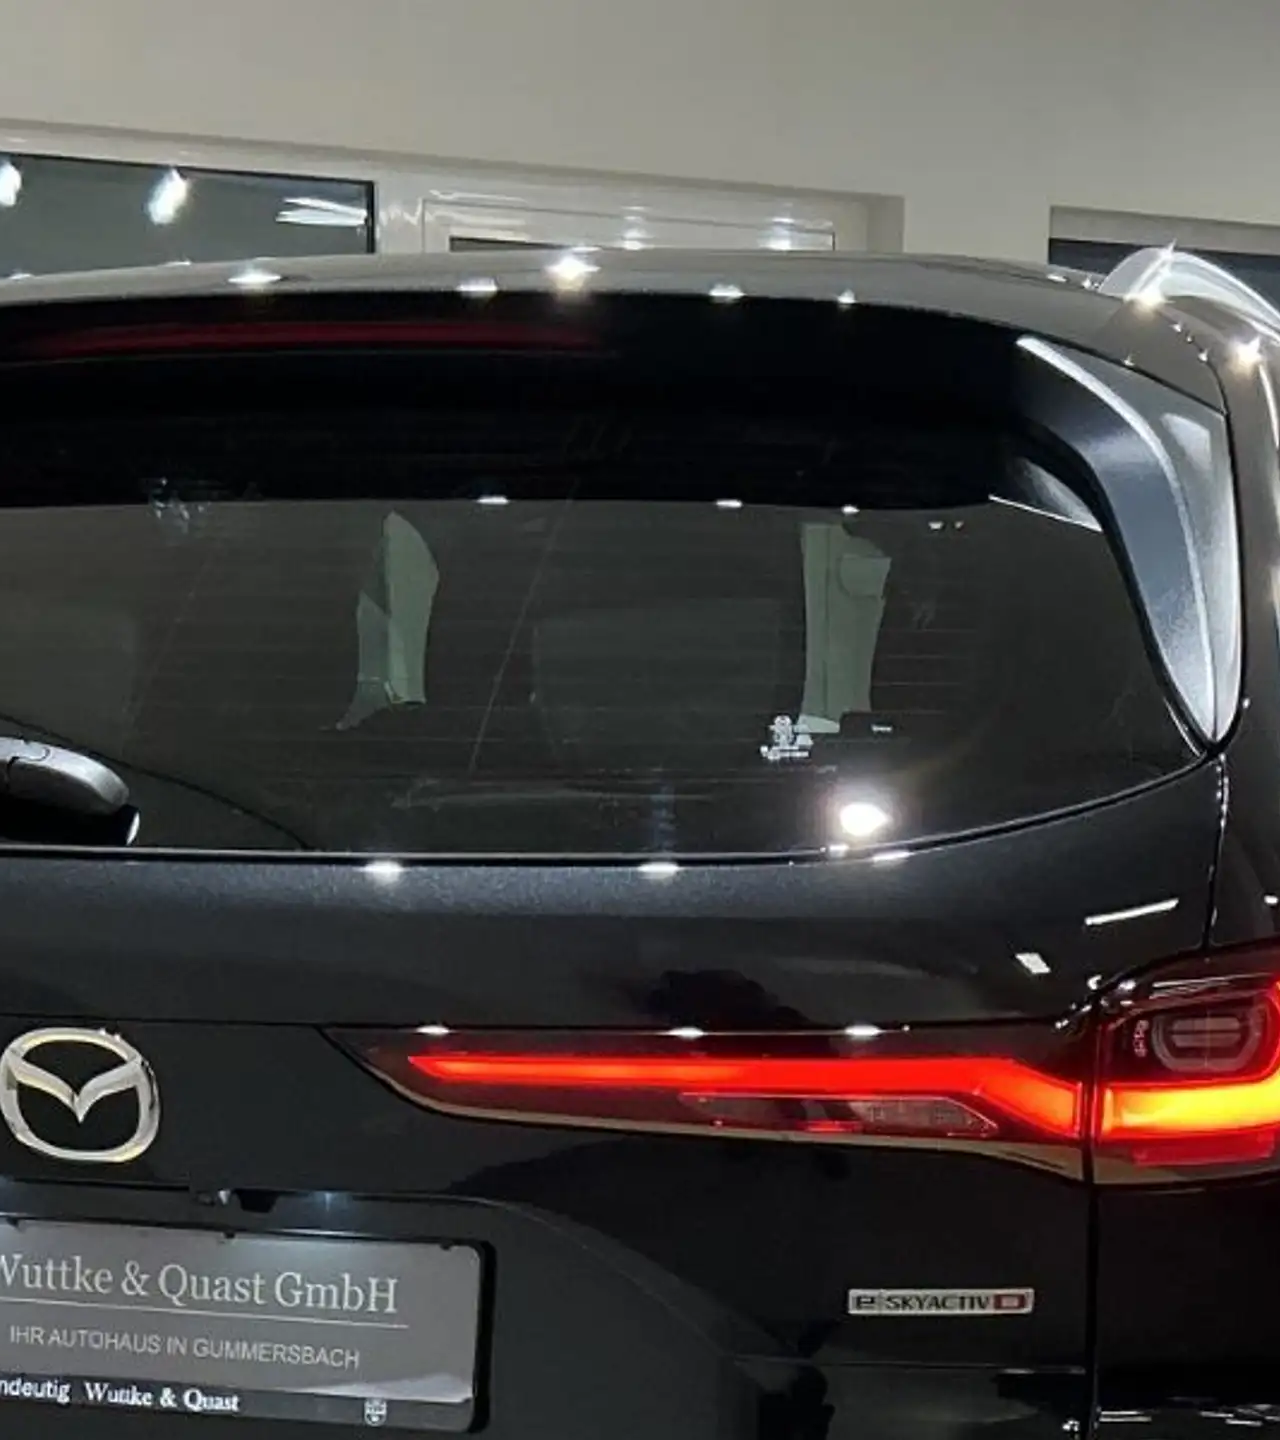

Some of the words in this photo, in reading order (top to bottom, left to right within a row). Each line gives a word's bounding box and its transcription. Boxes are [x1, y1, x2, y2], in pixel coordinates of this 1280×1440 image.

[121, 1260, 150, 1296] &
[157, 1263, 267, 1307] Quast
[275, 1271, 399, 1314] GmbH
[10, 1325, 44, 1345] IHR
[48, 1328, 162, 1355] AUTOHAUS
[166, 1336, 188, 1355] IN
[193, 1337, 360, 1369] GUMMERSBACH
[84, 1381, 154, 1406] Wuttke
[159, 1387, 177, 1407] &
[183, 1387, 241, 1413] Quast
